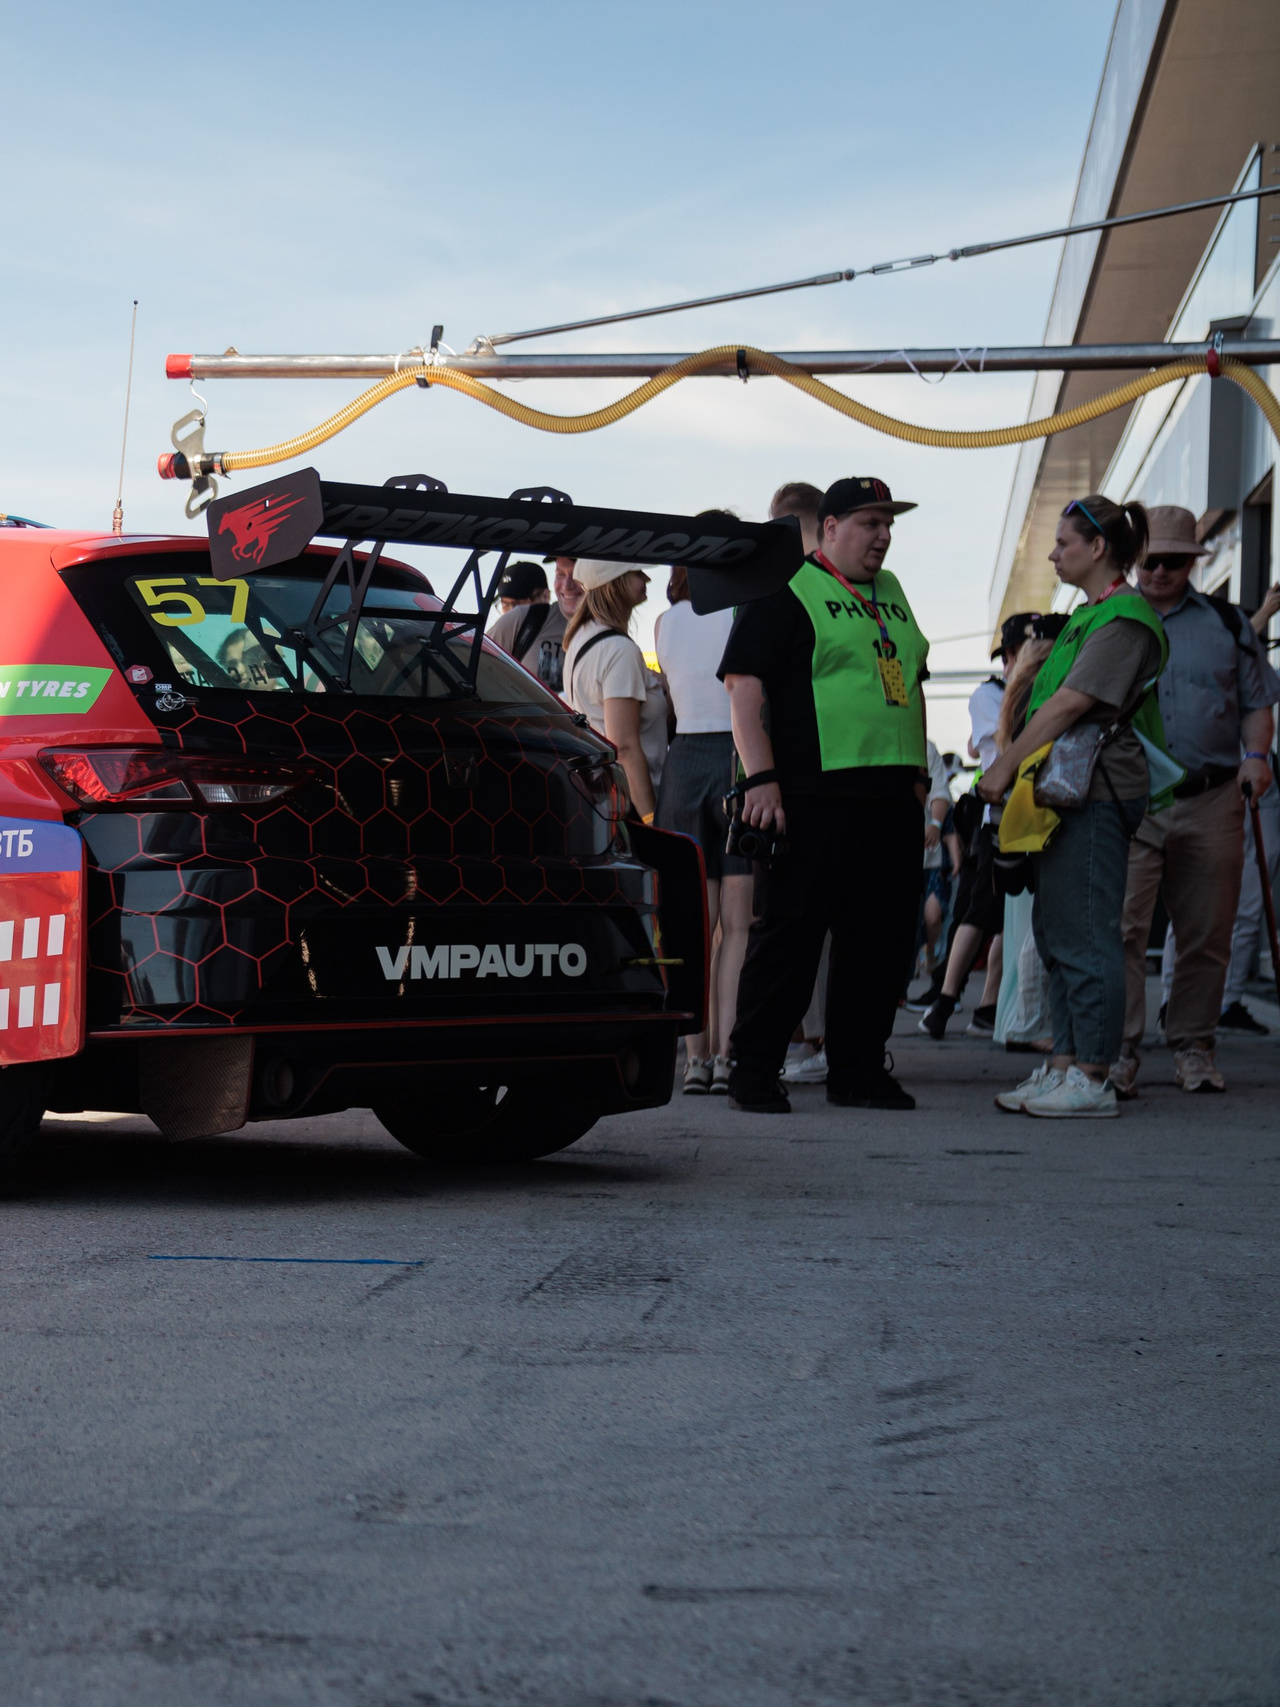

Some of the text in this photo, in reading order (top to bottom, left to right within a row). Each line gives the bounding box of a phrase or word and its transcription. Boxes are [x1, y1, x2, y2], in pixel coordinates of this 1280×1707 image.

[557, 525, 758, 564] МАСЛО
[135, 577, 250, 627] 57
[16, 680, 91, 699] TYRES
[375, 942, 588, 981] VMPAUTO
